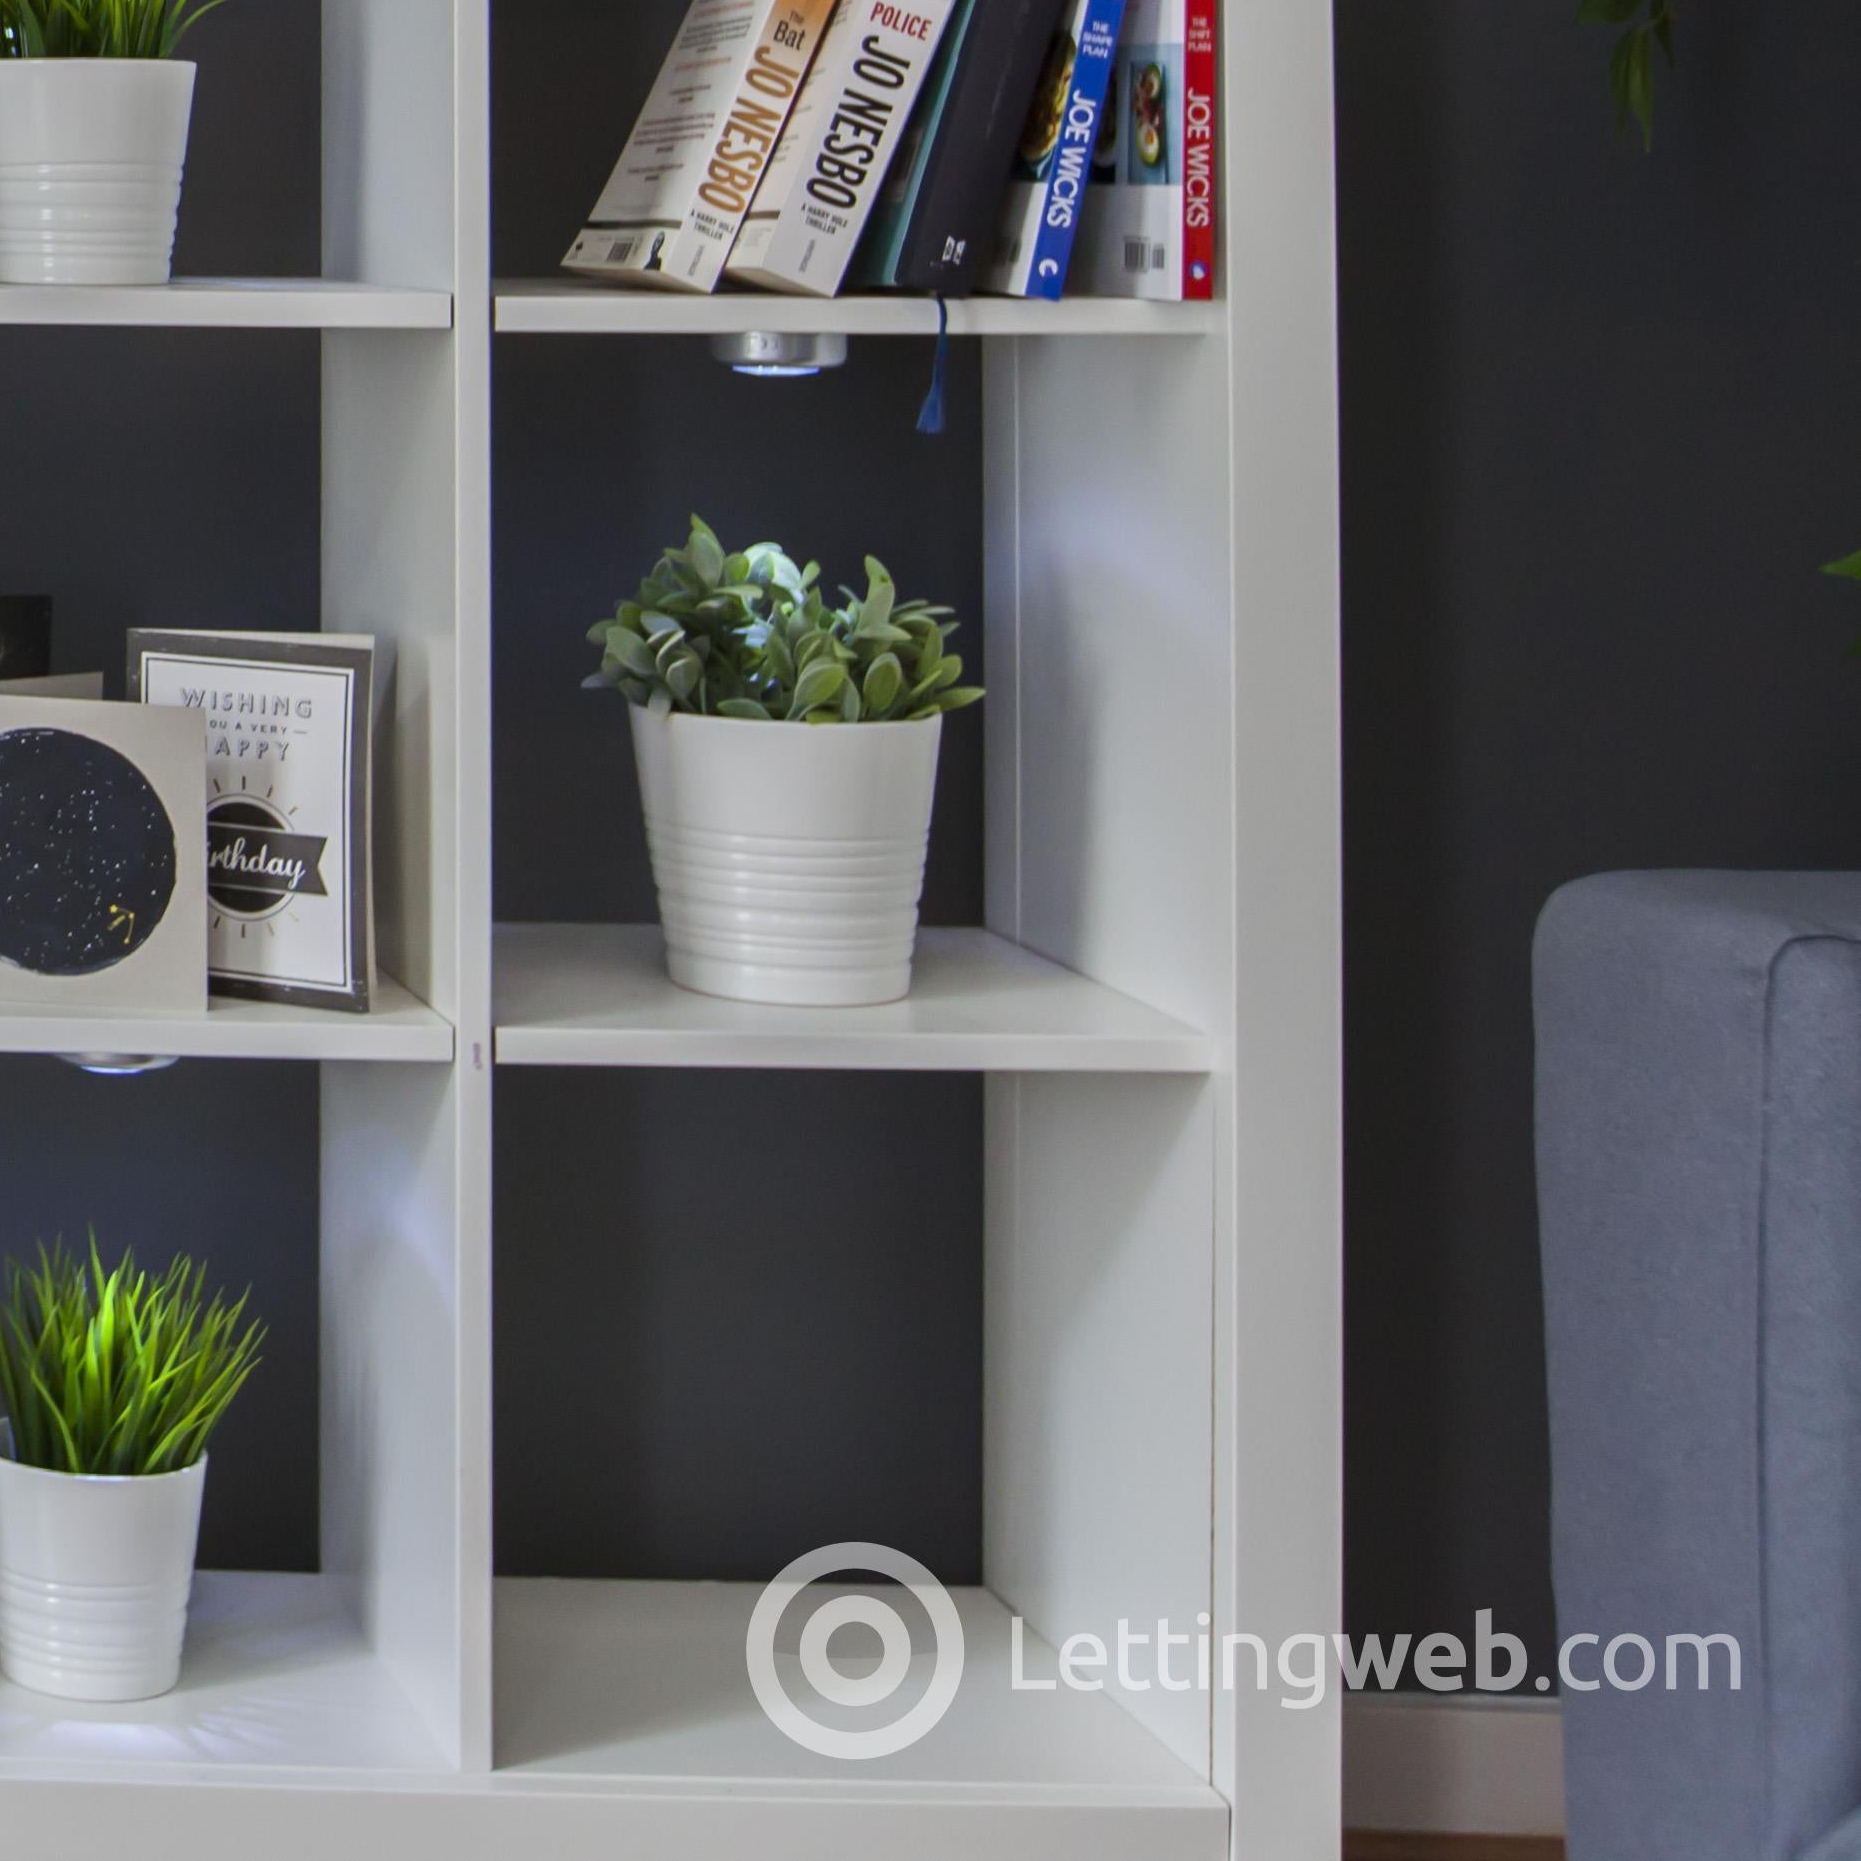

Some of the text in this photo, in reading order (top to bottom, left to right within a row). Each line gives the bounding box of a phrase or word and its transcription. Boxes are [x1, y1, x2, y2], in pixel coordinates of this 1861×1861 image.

[772, 20, 806, 51] Bat
[788, 9, 805, 23] The
[870, 0, 932, 41] POLICE
[1082, 43, 1108, 59] PLAN
[744, 45, 800, 99] JO
[806, 35, 911, 209] JO NESBO
[697, 96, 782, 214] NESBO
[1046, 89, 1097, 229] JOE WICKS
[1186, 88, 1211, 228] JOE WICKS
[181, 687, 313, 719] WISHING
[205, 737, 290, 762] APPY
[251, 724, 287, 734] VERY
[207, 837, 306, 890] rthday
